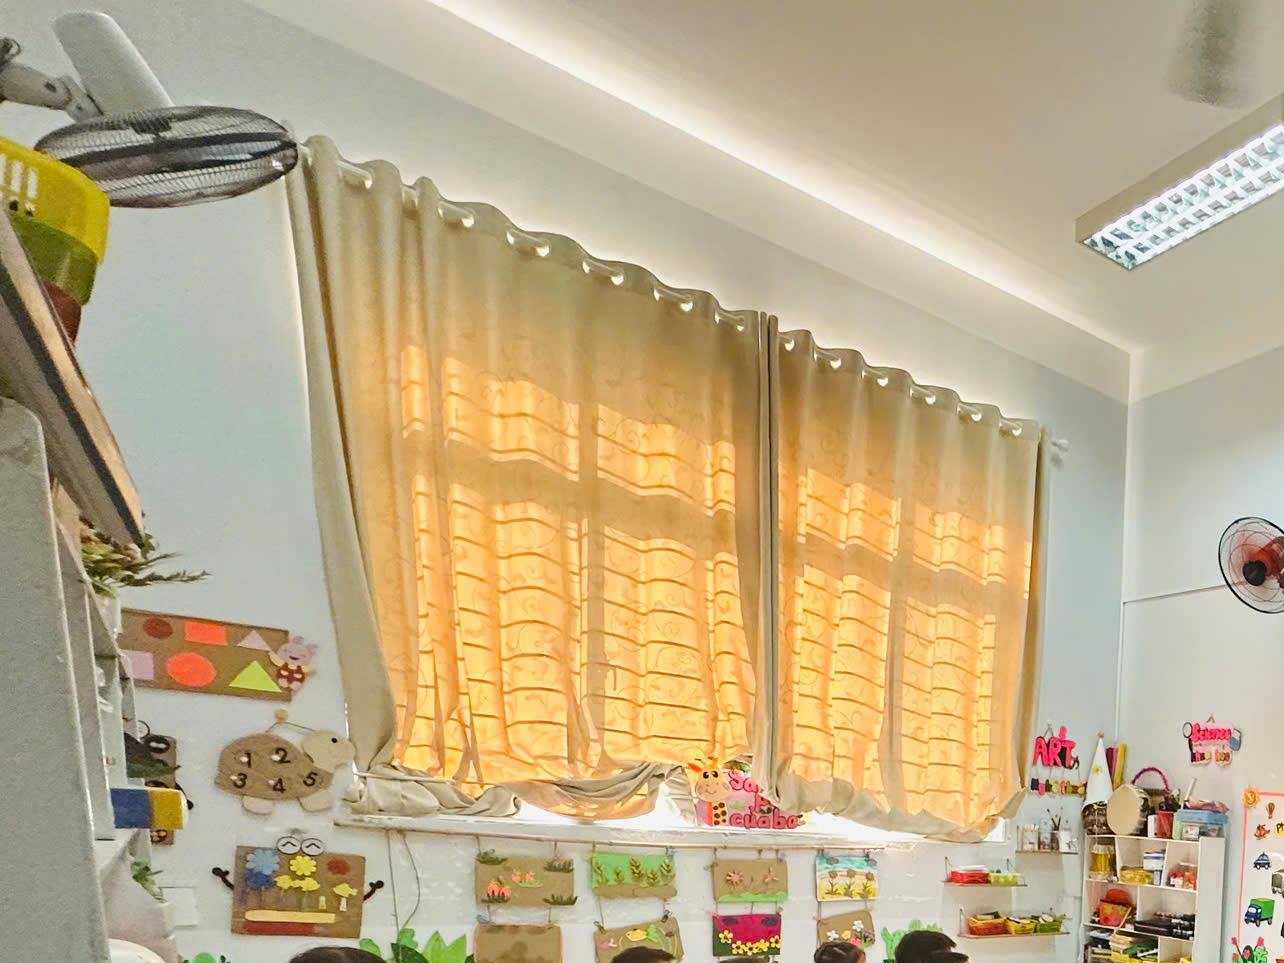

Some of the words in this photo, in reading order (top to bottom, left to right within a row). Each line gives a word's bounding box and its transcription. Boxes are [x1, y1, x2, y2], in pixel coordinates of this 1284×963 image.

[274, 747, 291, 764] 2
[1033, 735, 1077, 770] ART
[232, 773, 248, 789] 3
[272, 777, 286, 794] 4
[303, 771, 318, 787] 5
